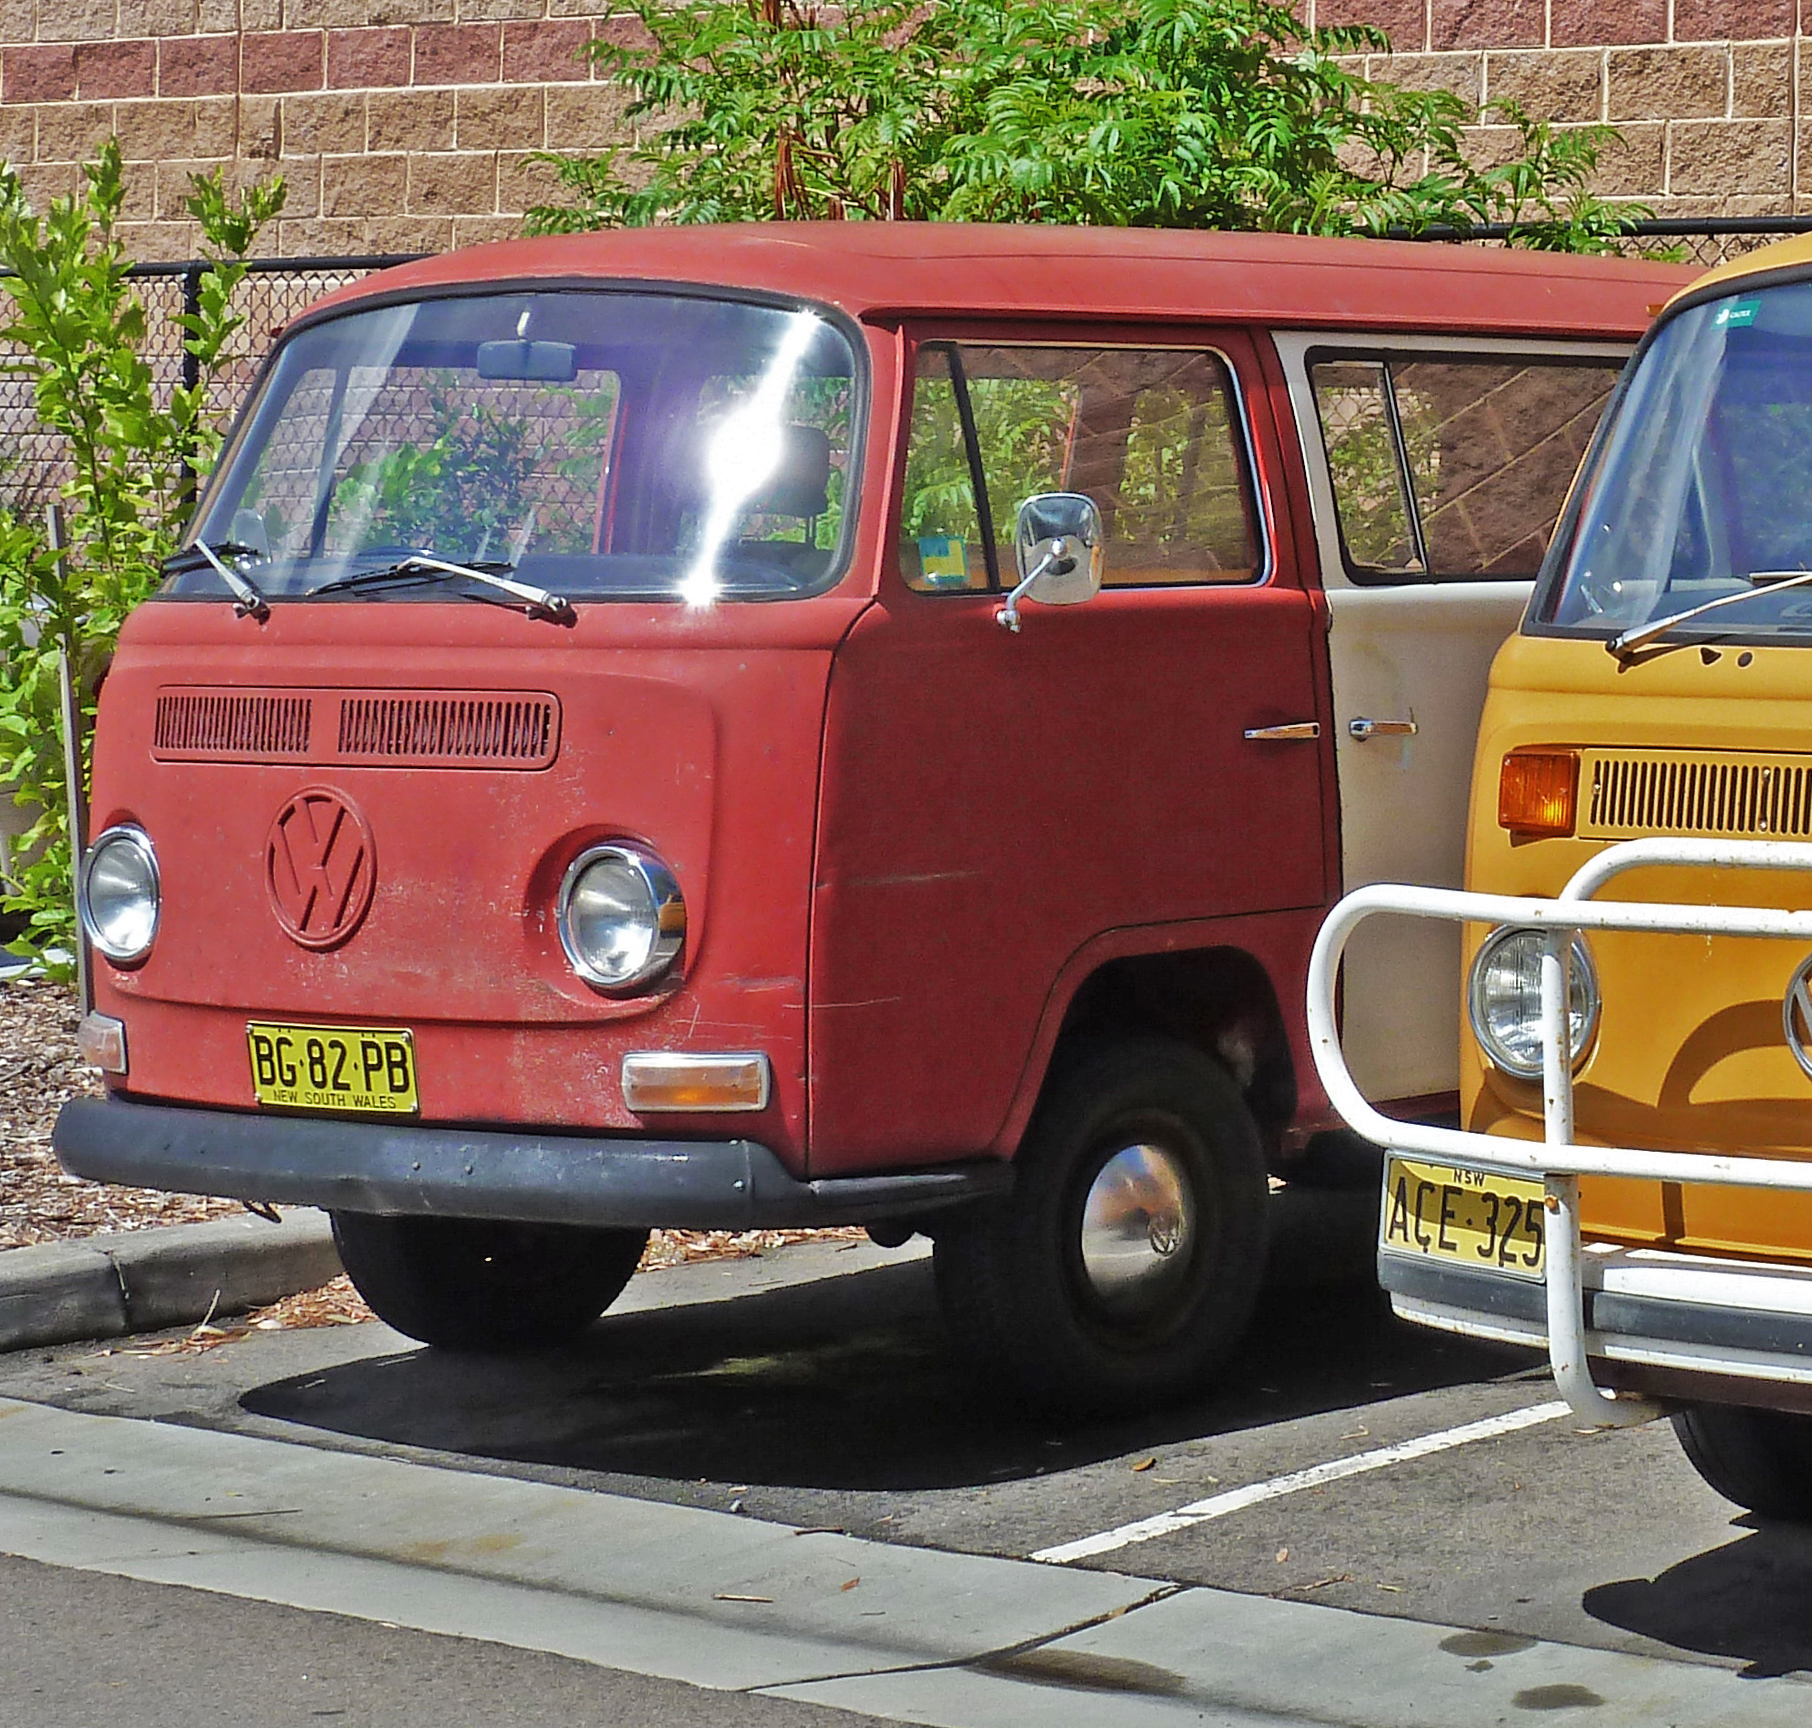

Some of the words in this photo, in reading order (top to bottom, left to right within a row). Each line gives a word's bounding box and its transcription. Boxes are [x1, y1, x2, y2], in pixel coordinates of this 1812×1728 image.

[273, 1090, 298, 1103] NEW
[304, 1091, 347, 1107] SOUTH
[353, 1094, 396, 1109] WALES
[1452, 1168, 1486, 1188] NSW
